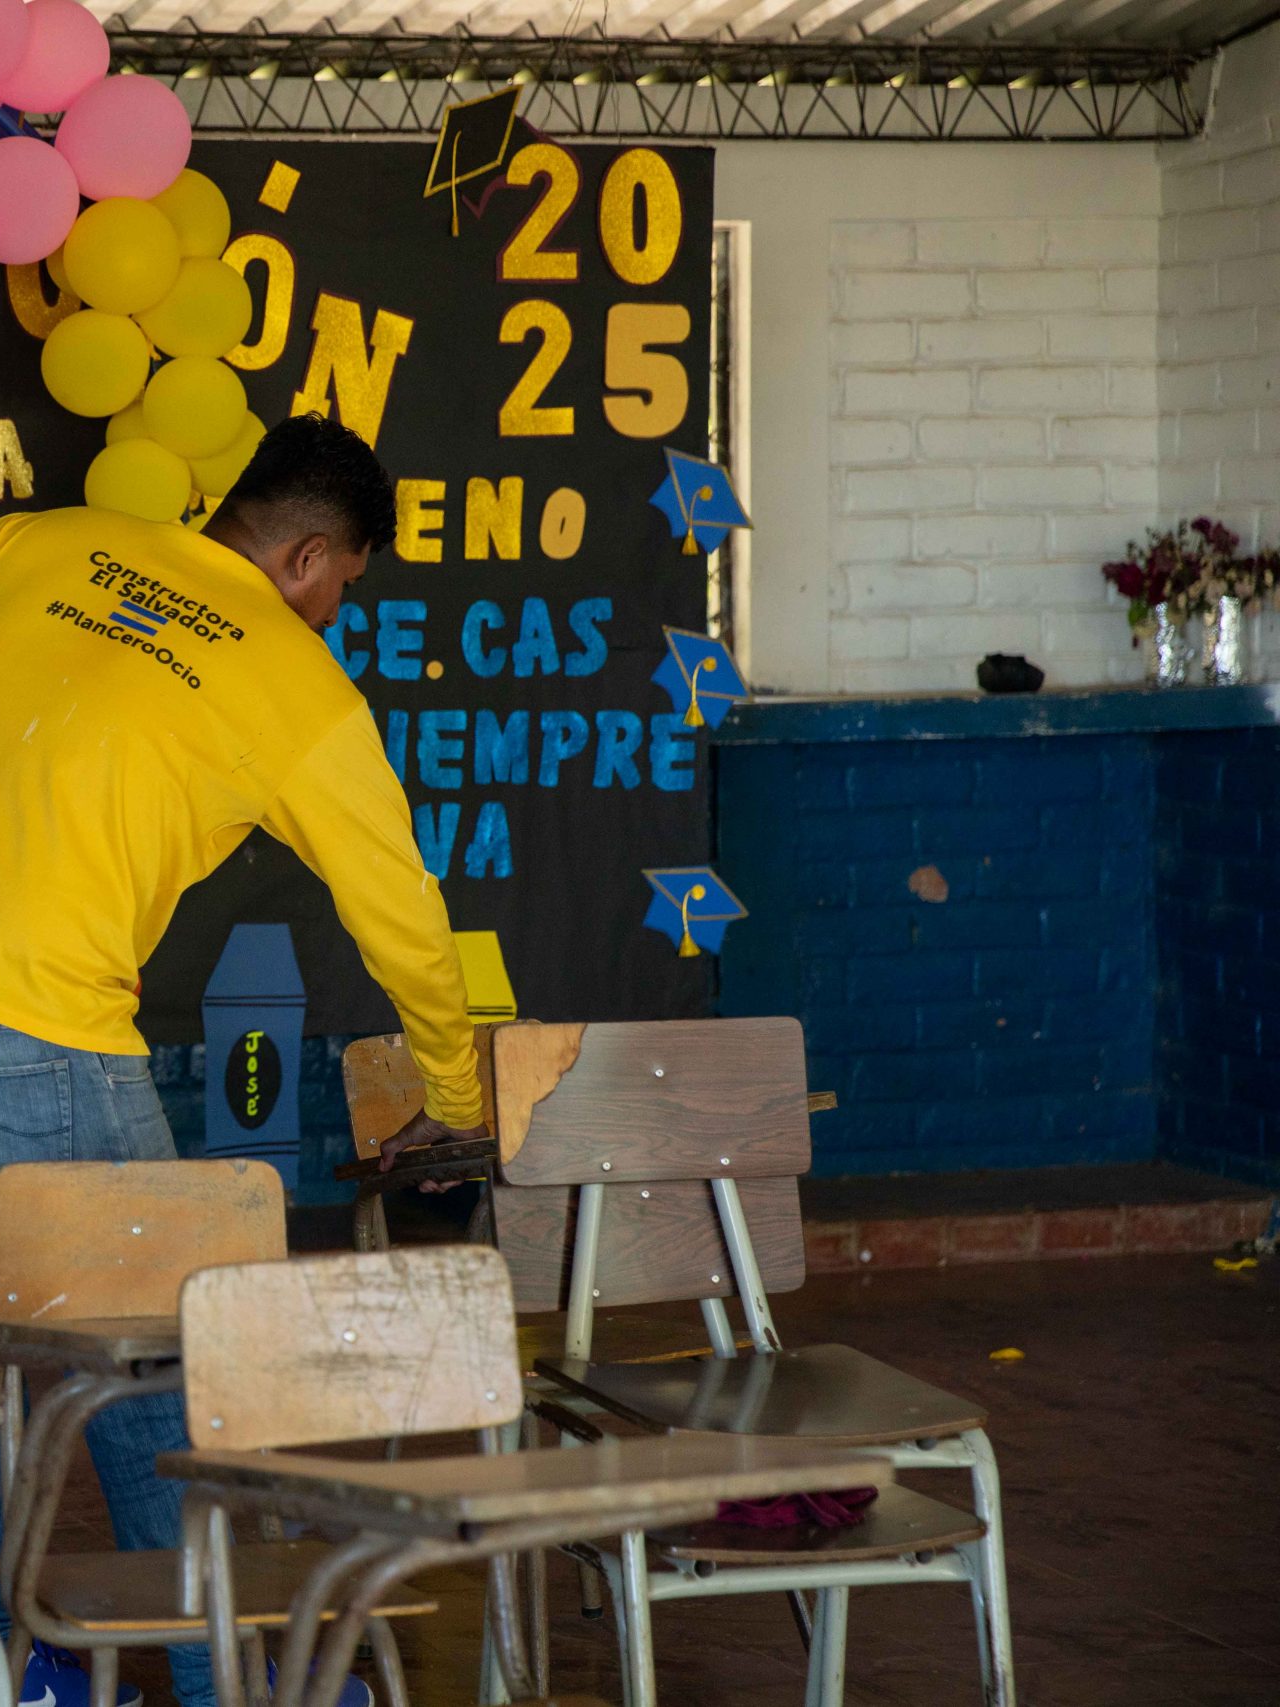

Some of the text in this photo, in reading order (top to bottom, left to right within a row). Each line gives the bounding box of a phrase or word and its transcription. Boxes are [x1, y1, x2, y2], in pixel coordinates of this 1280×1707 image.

[497, 142, 684, 287] 20
[498, 298, 692, 440] 25
[88, 550, 246, 642] Constructora
[88, 569, 223, 644] El Salvador
[460, 596, 614, 679] CAS
[45, 599, 202, 690] #PlanCeroOcio
[372, 708, 697, 792] IEMPRE
[412, 801, 515, 881] VA
[244, 1030, 265, 1117] José
